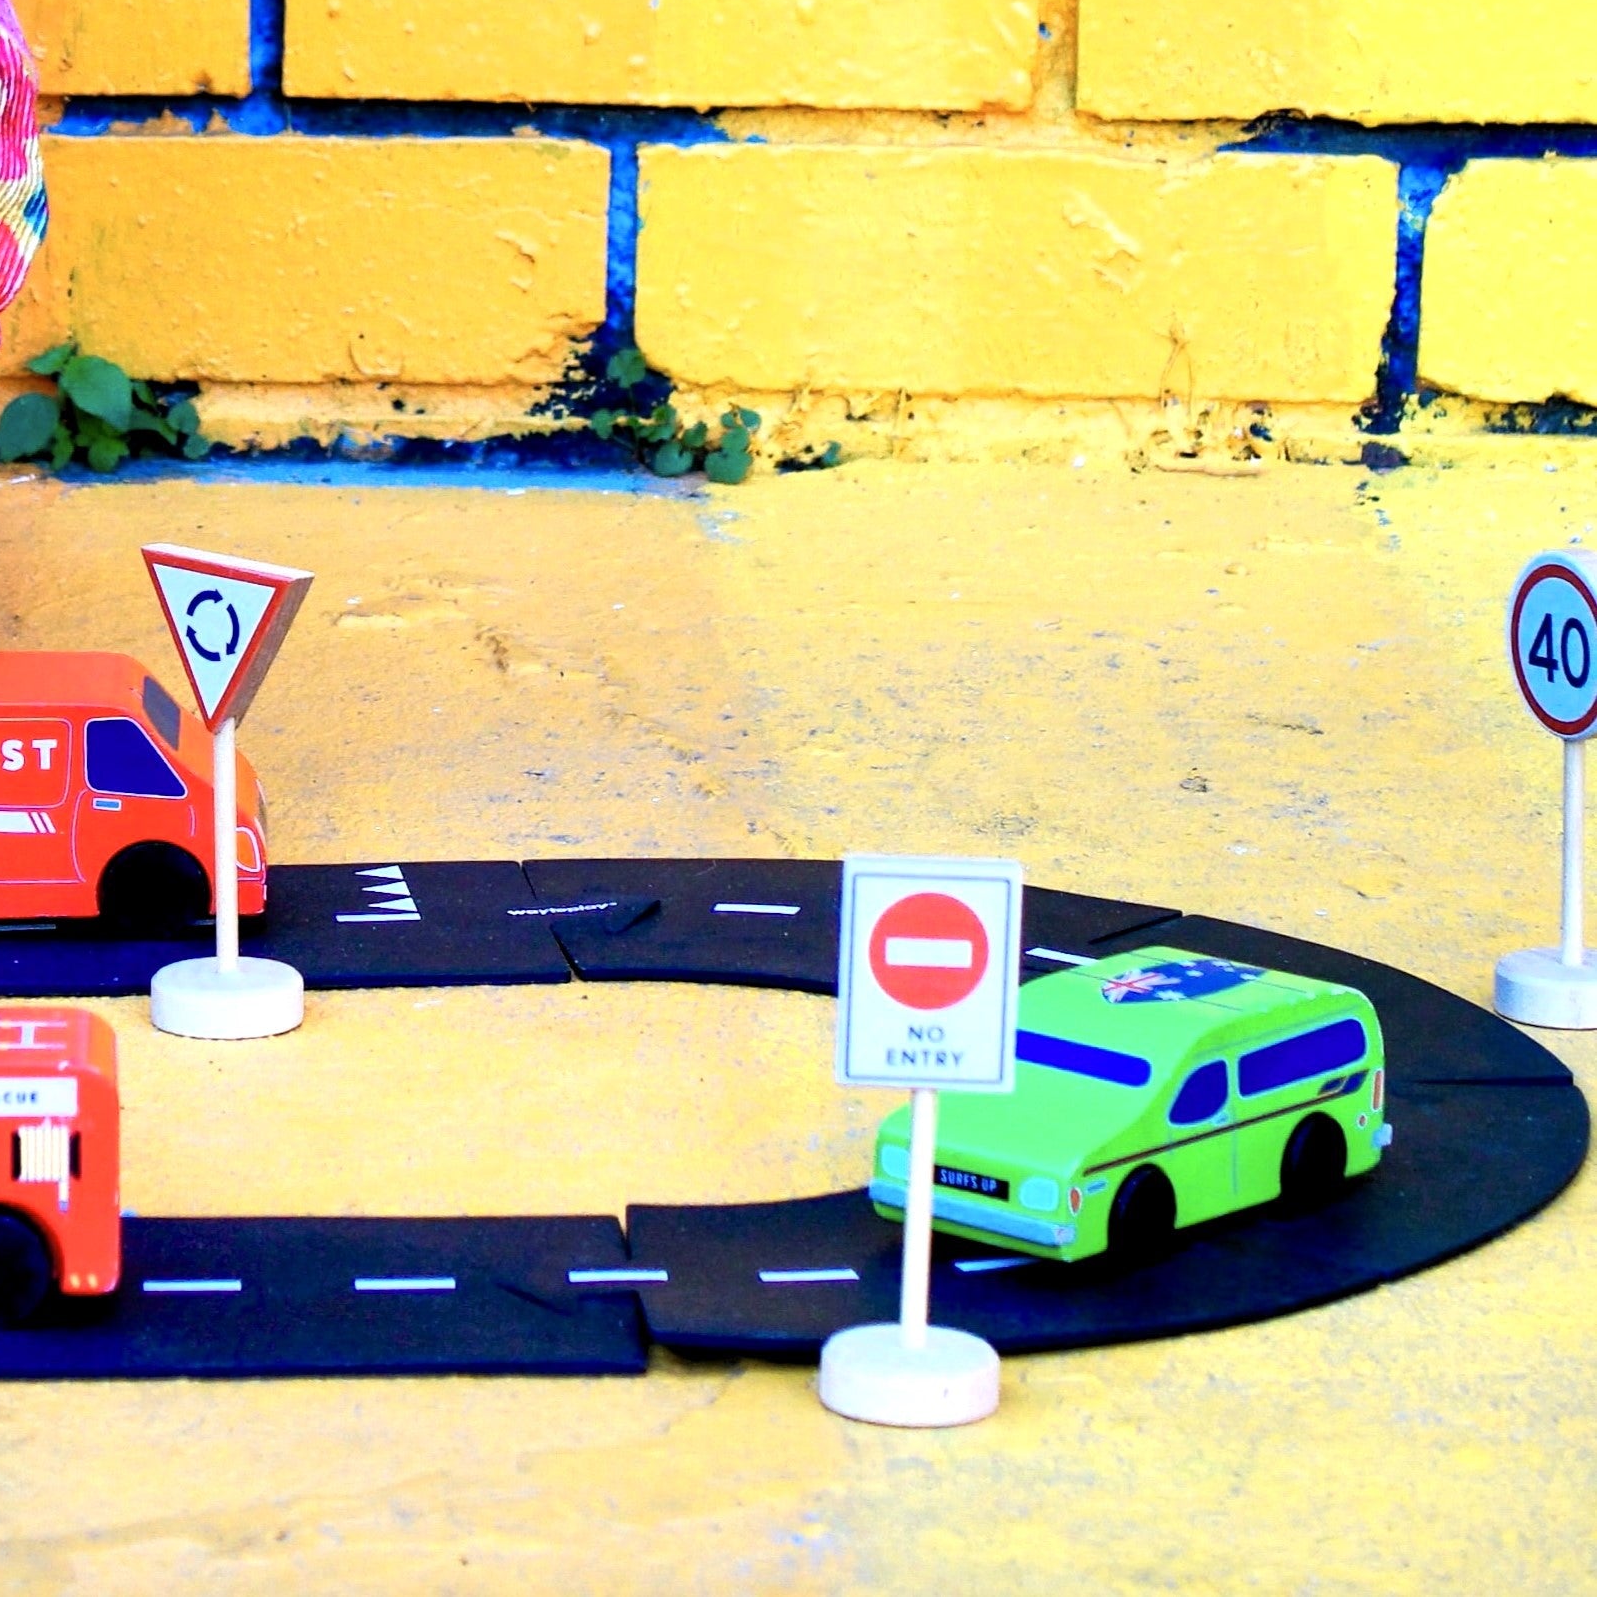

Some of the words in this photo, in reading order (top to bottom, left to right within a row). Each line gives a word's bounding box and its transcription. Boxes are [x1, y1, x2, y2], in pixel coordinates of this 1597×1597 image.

[1527, 612, 1591, 689] 40
[906, 1024, 946, 1044] NO
[885, 1048, 964, 1067] ENTRY
[981, 1177, 997, 1193] UP
